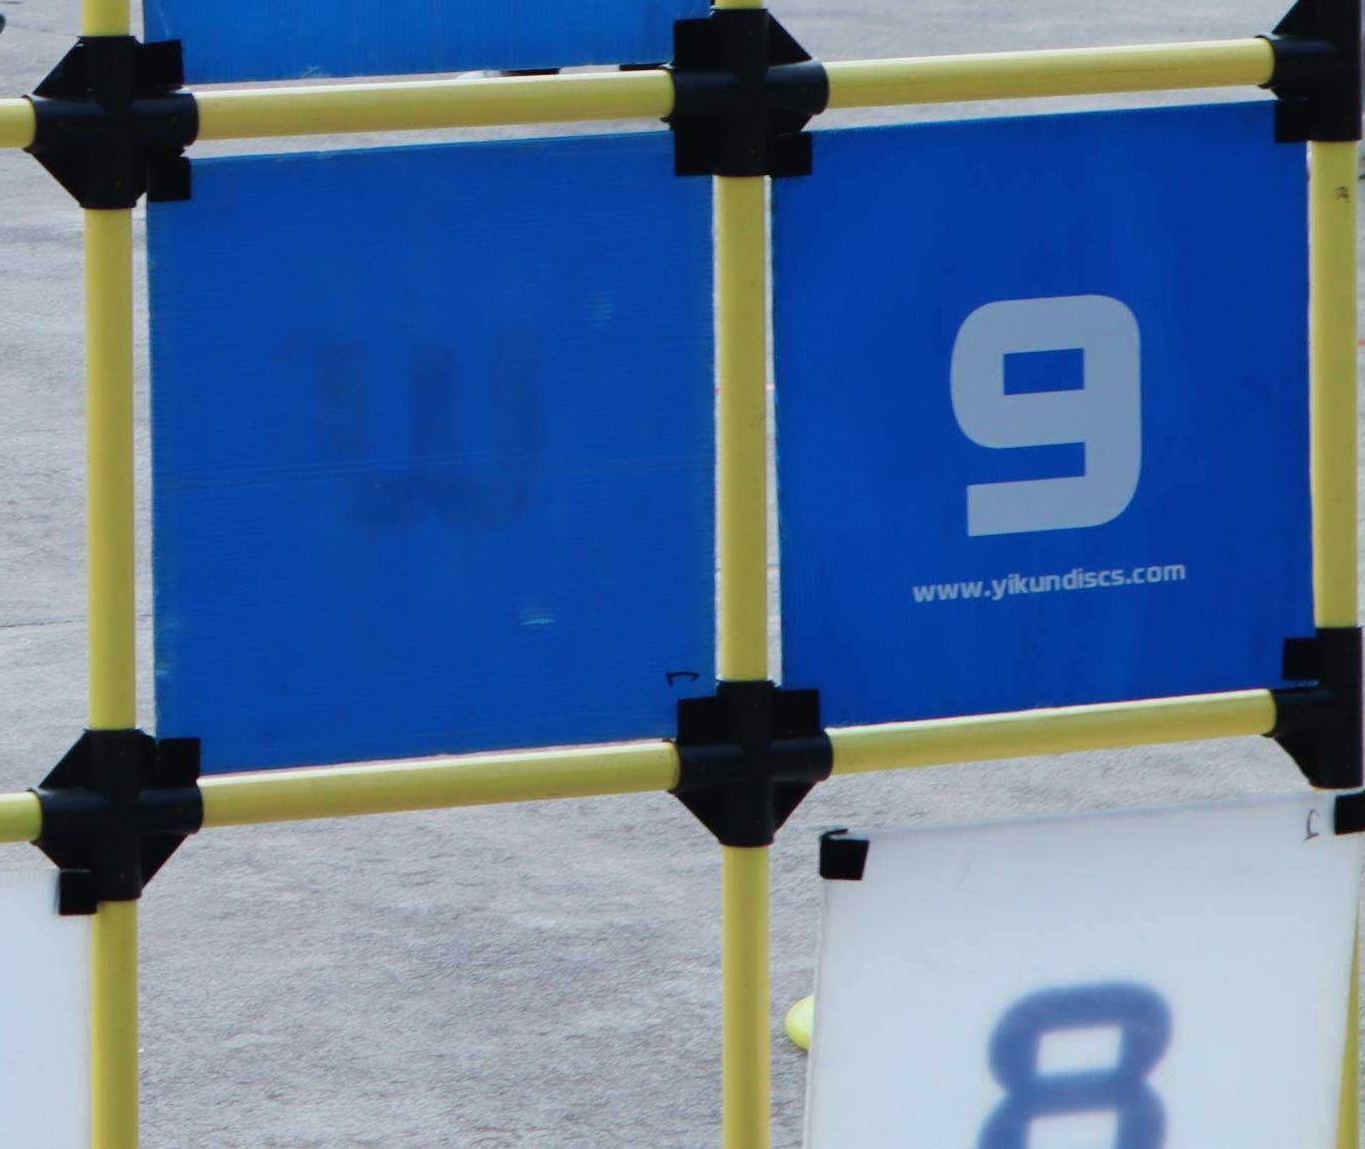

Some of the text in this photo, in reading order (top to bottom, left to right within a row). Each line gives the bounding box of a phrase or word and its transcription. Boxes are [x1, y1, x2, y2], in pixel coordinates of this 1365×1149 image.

[950, 294, 1141, 536] 9
[912, 564, 1186, 602] www.yikundiscs.com
[977, 980, 1174, 1149] 8
